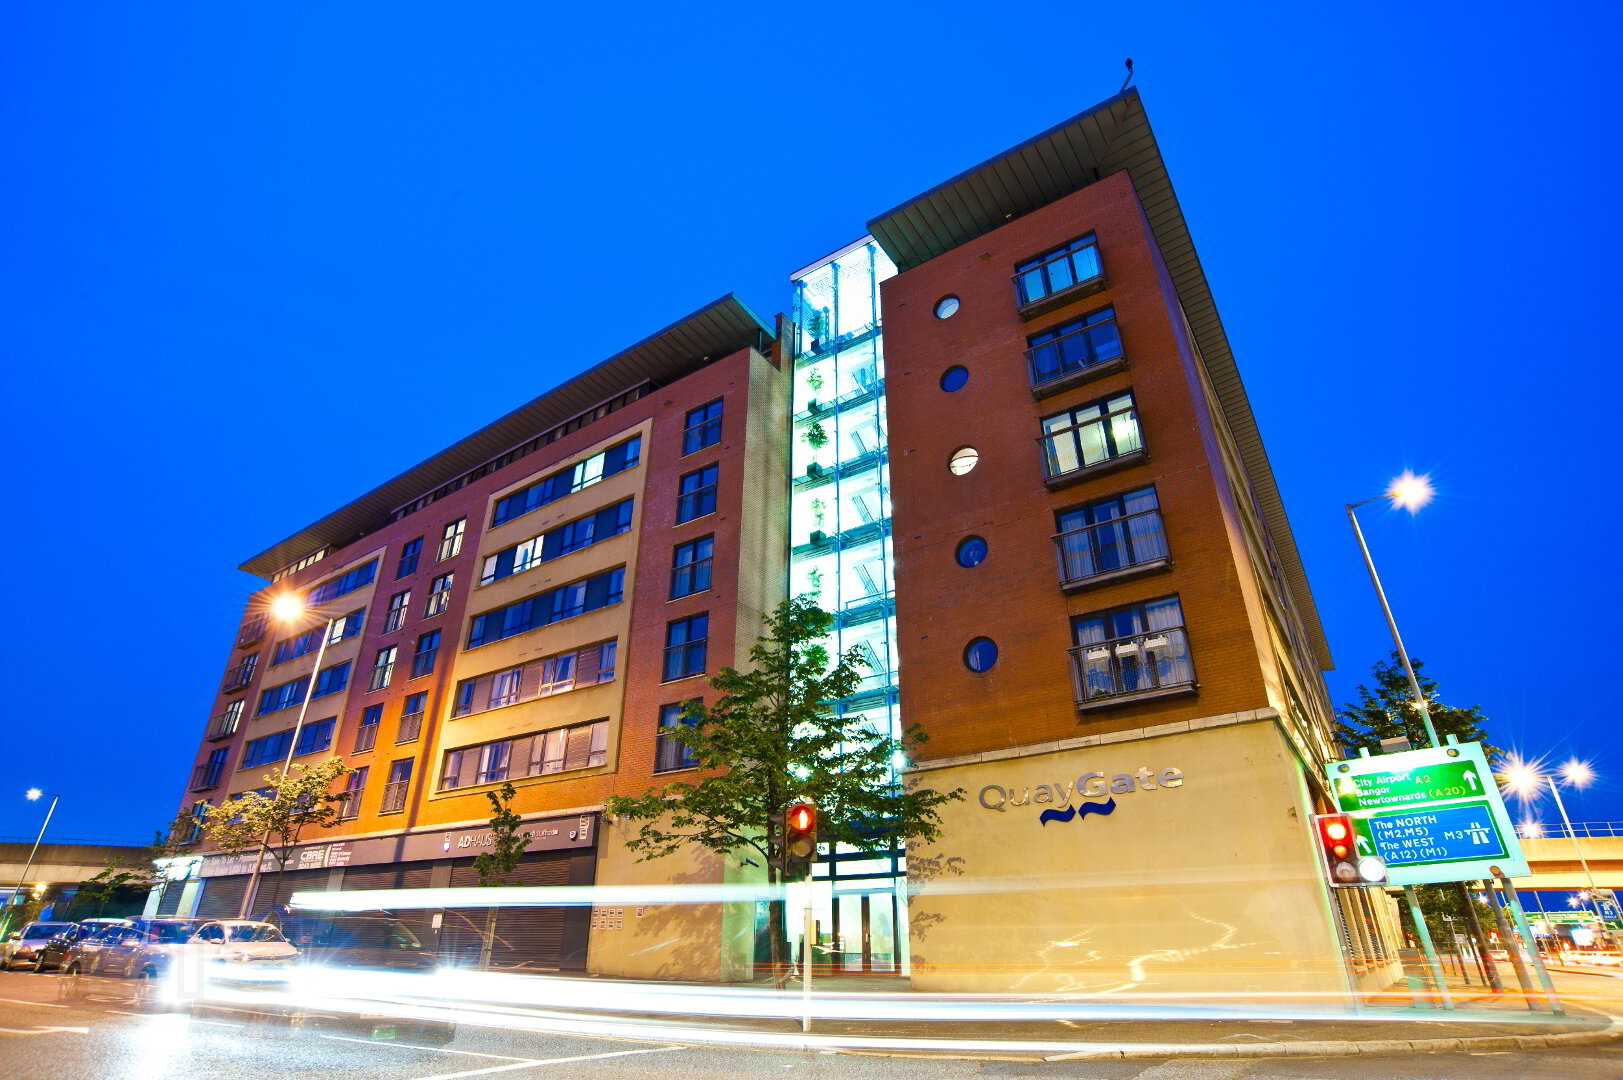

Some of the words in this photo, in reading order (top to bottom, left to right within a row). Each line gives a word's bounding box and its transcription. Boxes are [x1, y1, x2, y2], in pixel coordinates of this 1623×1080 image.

[1353, 778, 1372, 787] City
[1376, 773, 1412, 784] Airport
[1415, 774, 1432, 784] A2
[978, 765, 1185, 812] QuayGate
[1356, 786, 1391, 797] Bangor
[1359, 791, 1428, 806] Newtownards
[1428, 785, 1466, 799] (A20)
[1374, 821, 1394, 830] The
[1395, 815, 1437, 828] NORTH
[1443, 830, 1464, 840] M3
[1380, 841, 1400, 850] The
[1402, 837, 1435, 849] WEST
[1384, 850, 1418, 862] (A12)
[1420, 847, 1449, 859] (M1)
